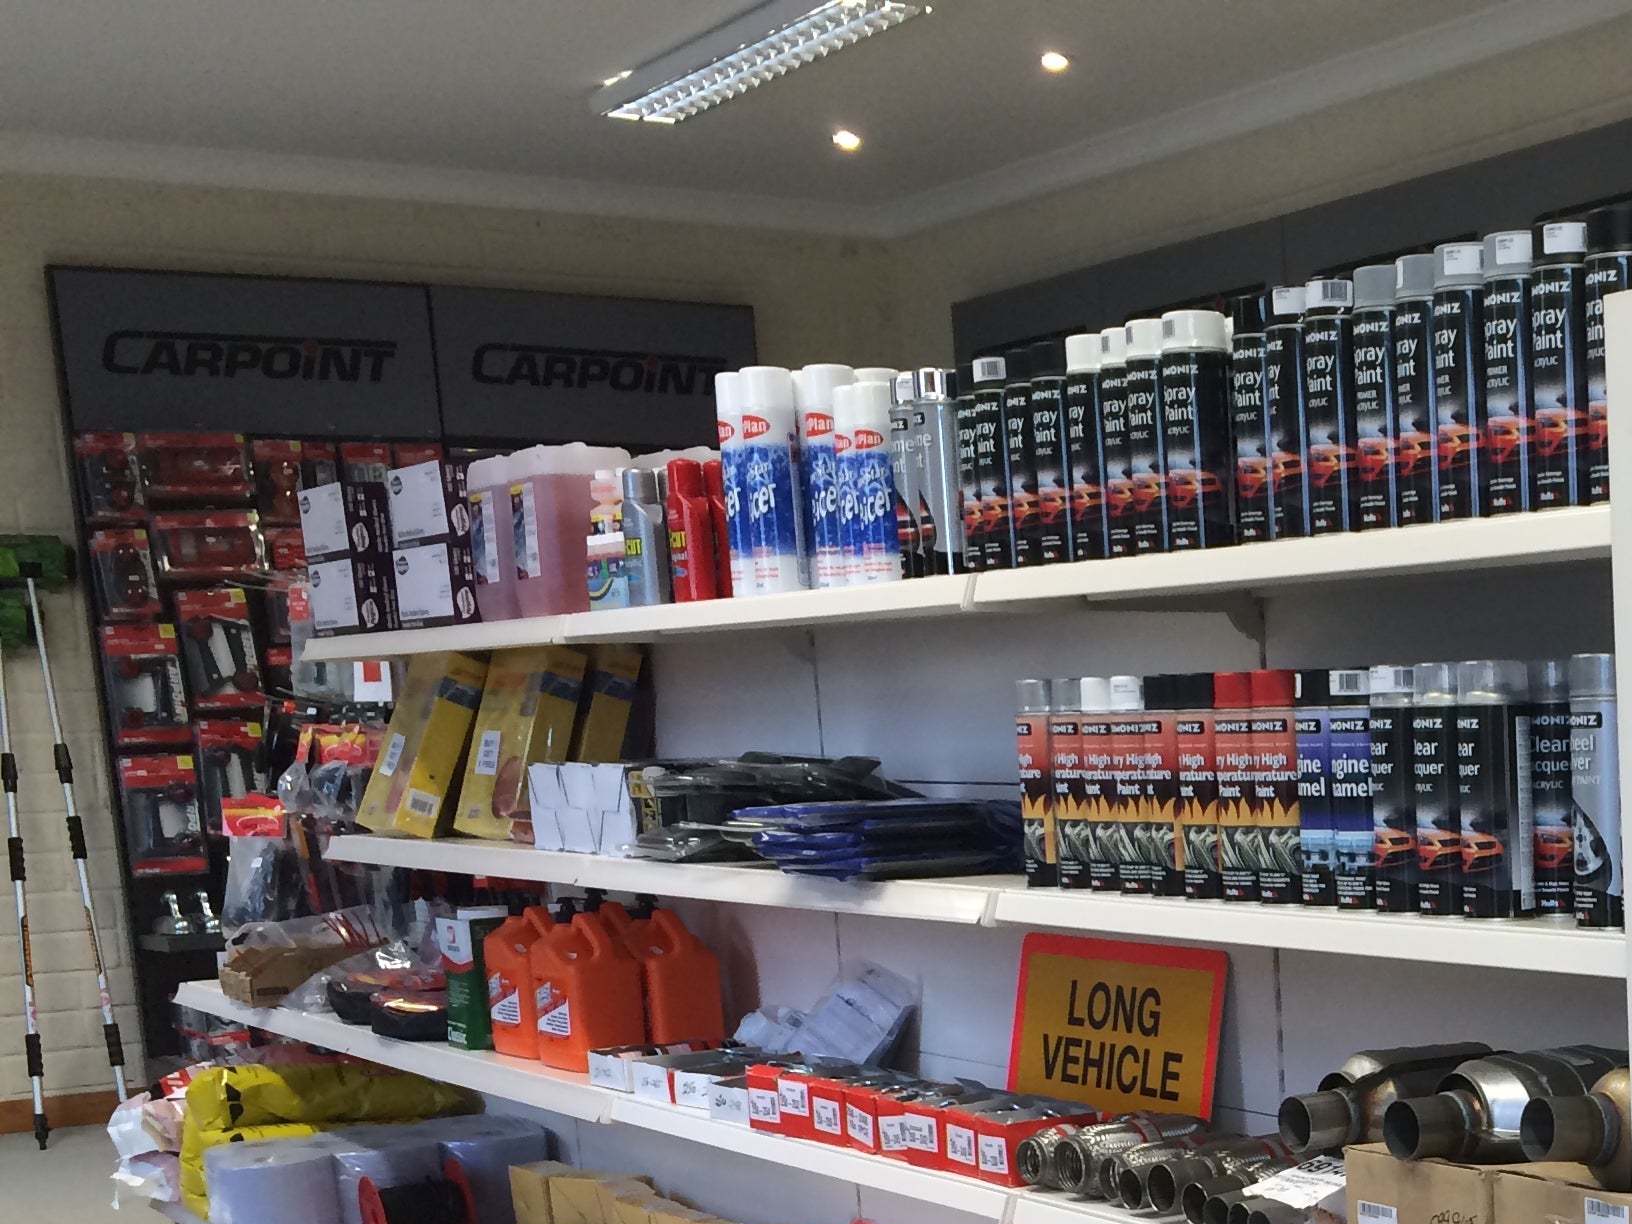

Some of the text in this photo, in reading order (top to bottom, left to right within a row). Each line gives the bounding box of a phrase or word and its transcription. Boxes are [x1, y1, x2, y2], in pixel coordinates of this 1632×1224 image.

[1532, 281, 1570, 296] MONIZ
[1307, 355, 1335, 374] pray
[1067, 977, 1161, 1037] LONG
[1041, 1033, 1184, 1101] VEHICLE
